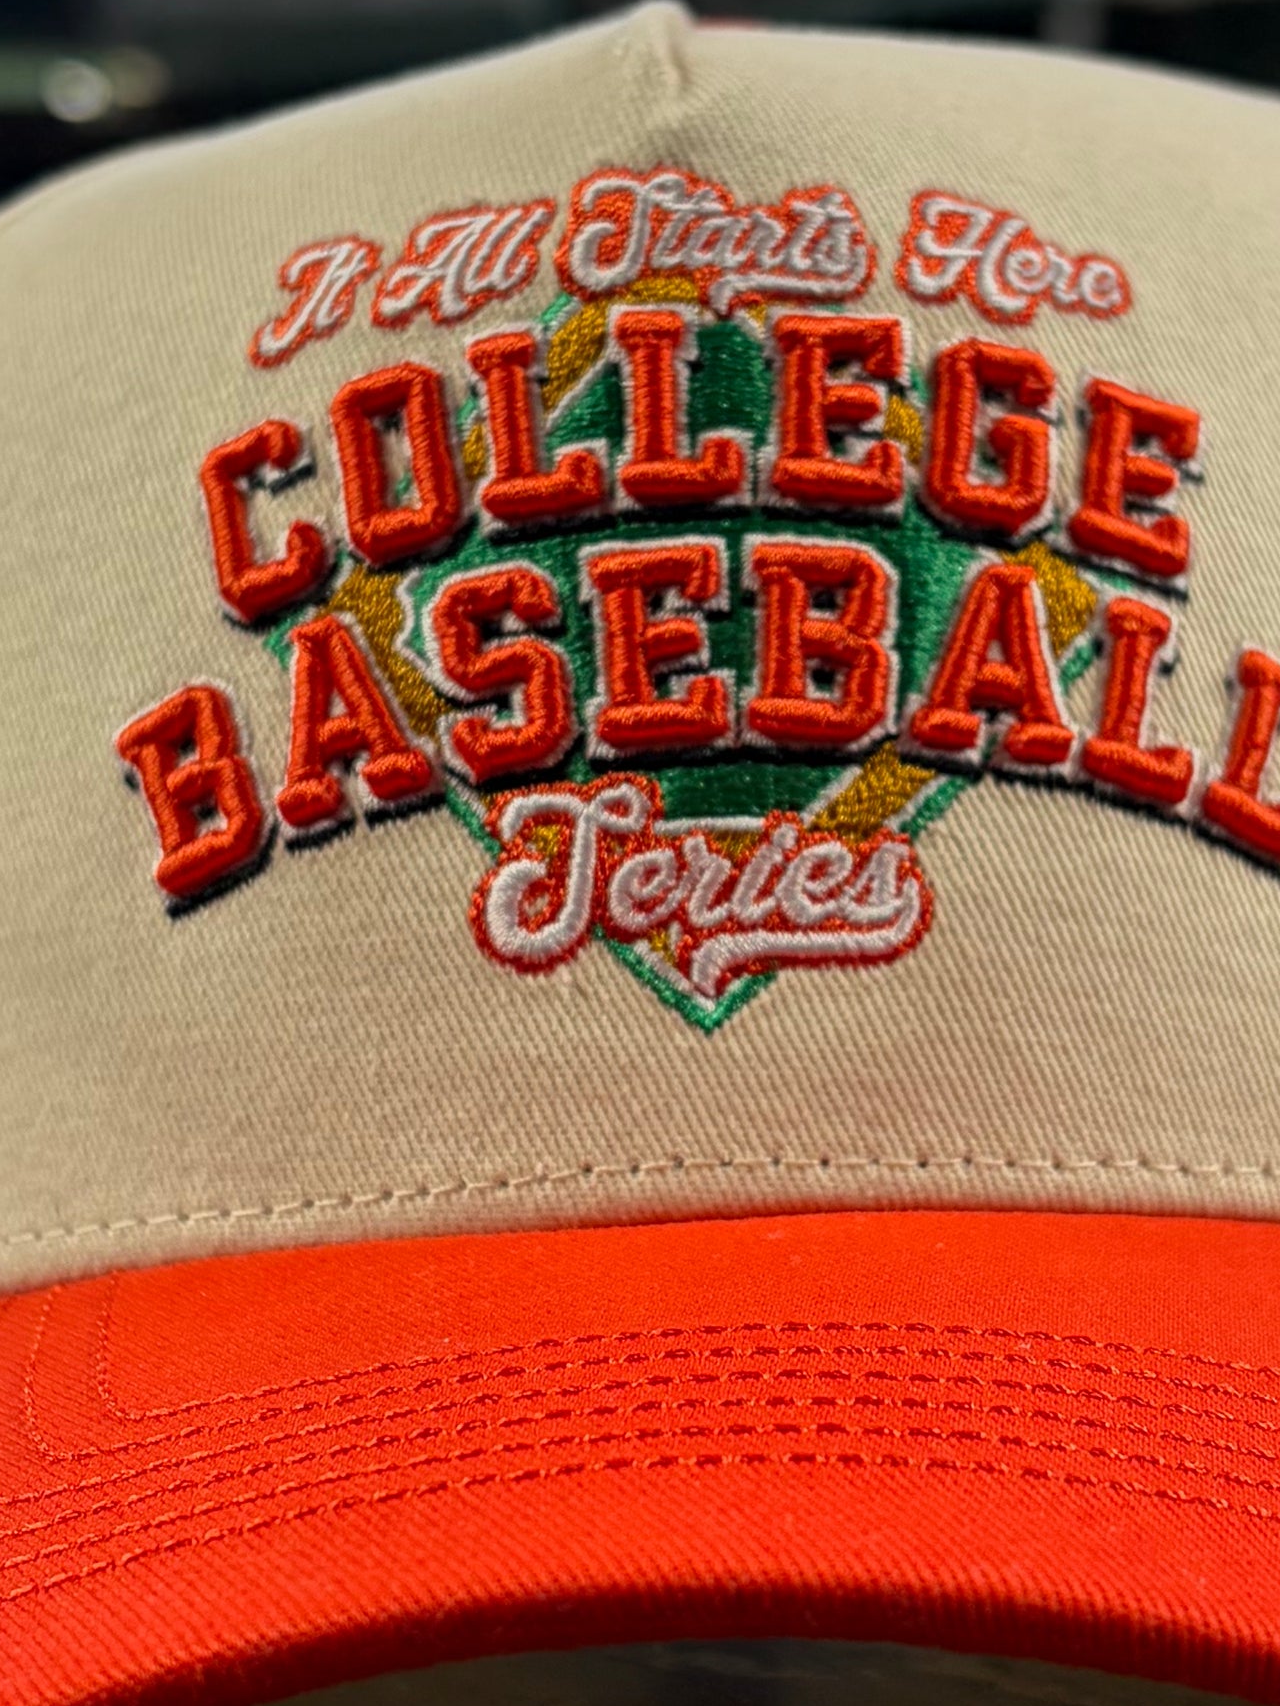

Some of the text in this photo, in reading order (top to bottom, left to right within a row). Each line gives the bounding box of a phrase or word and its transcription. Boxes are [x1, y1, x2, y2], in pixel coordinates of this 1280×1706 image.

[251, 167, 1131, 366] It All Starts Here
[198, 306, 1203, 621] COLLEGE
[467, 771, 934, 997] Series
